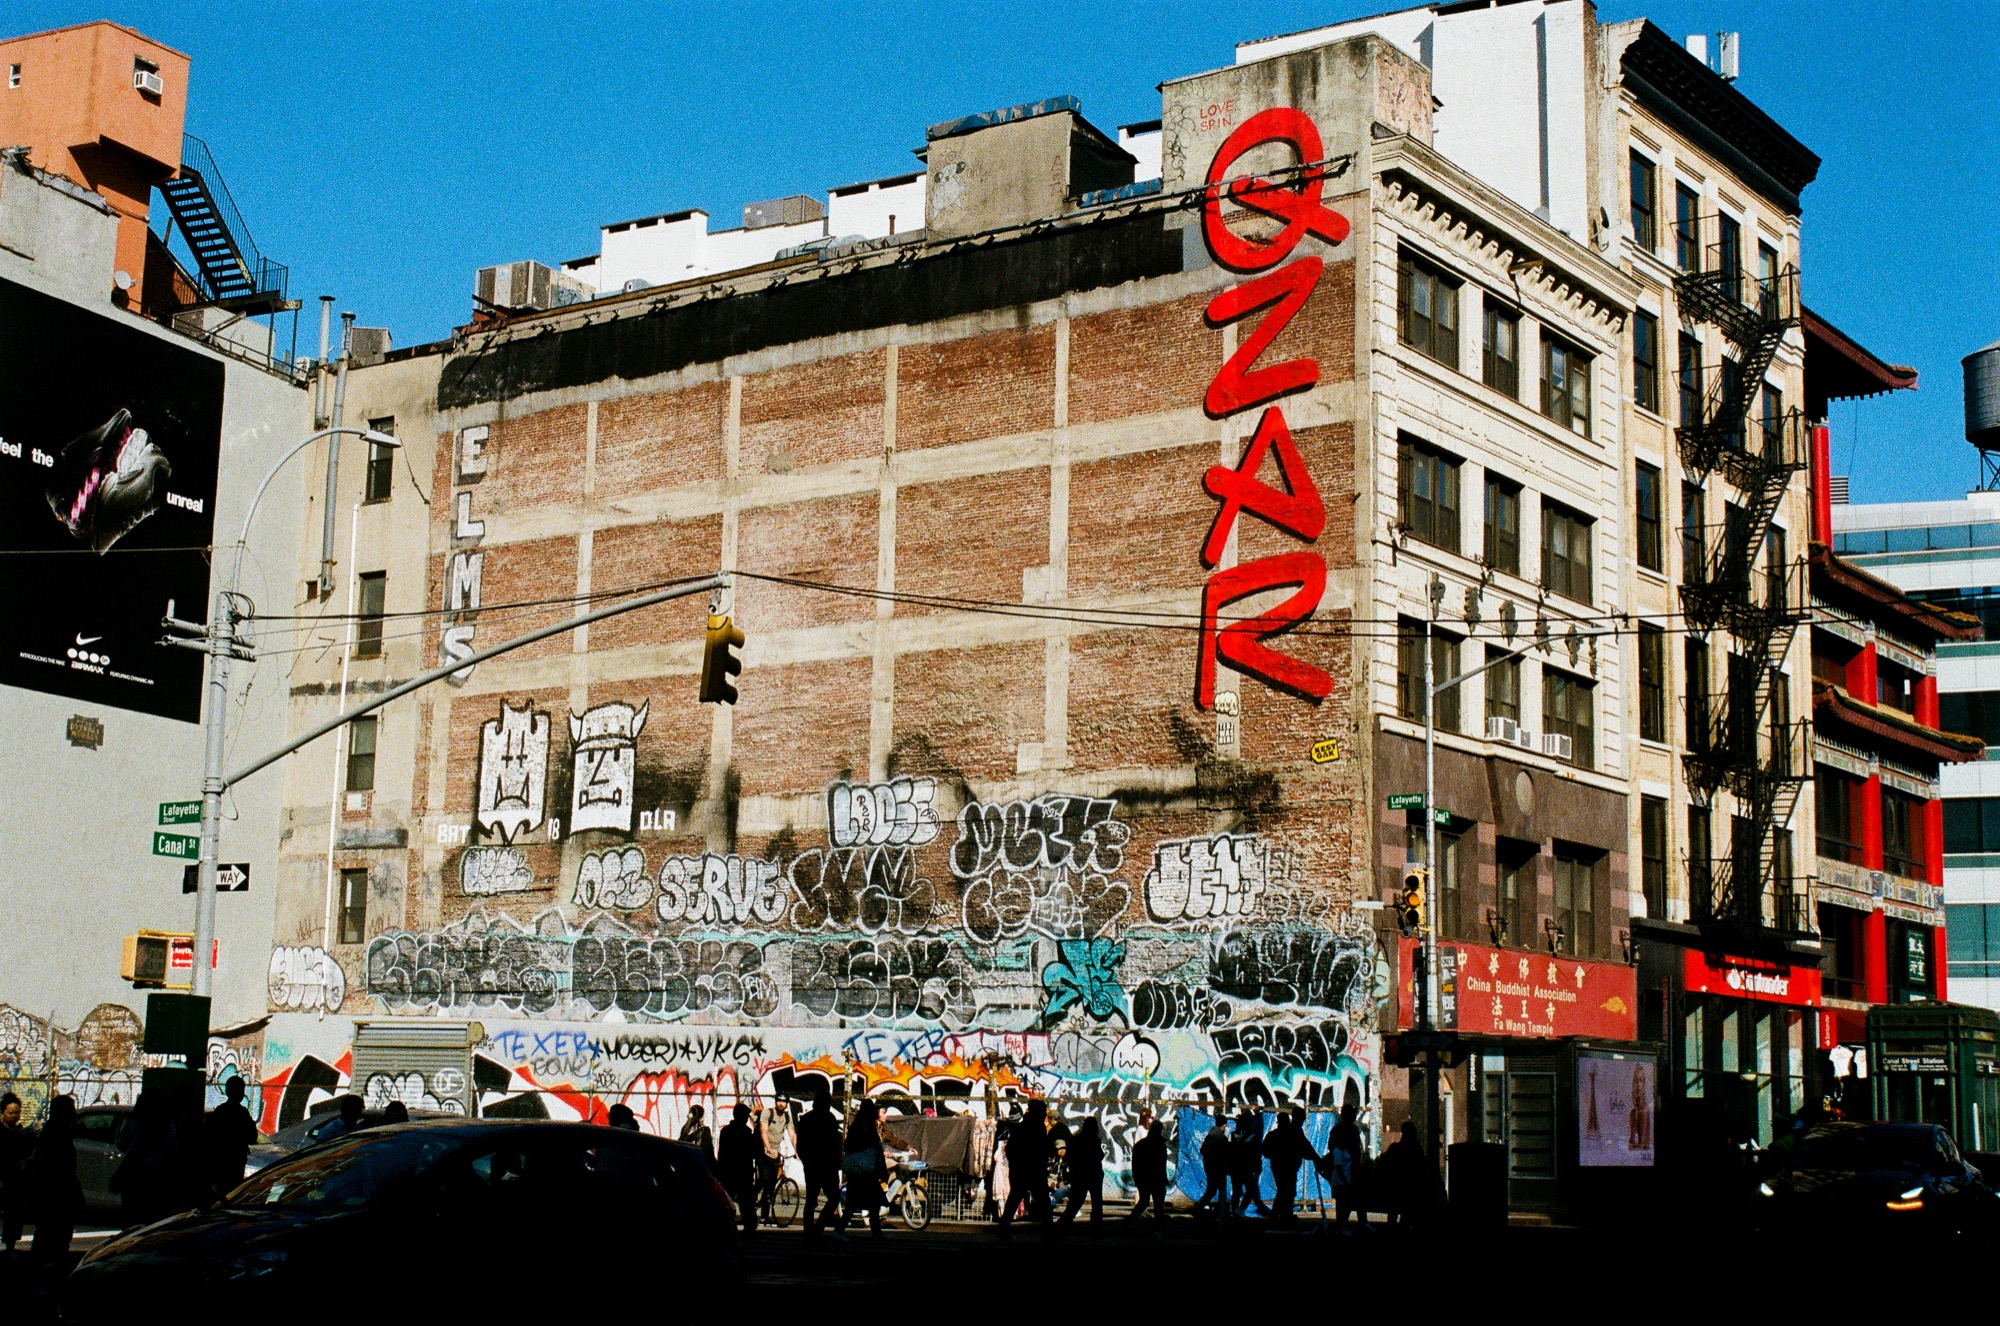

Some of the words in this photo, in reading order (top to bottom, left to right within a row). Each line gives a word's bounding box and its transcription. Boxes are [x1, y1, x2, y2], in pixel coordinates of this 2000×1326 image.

[1200, 99, 1235, 119] LOVE
[1200, 114, 1232, 132] SPIN
[31, 447, 54, 468] the
[166, 491, 204, 514] unreal
[441, 425, 489, 688] ELMS
[163, 803, 200, 818] Lafayette
[1391, 794, 1422, 806] Lafayette
[158, 835, 186, 856] Canal
[188, 838, 196, 849] St
[437, 823, 471, 844] BAT
[220, 872, 240, 883] WAY
[656, 852, 789, 924] SERVE
[1457, 948, 1586, 989] 中華佛教會
[1467, 976, 1491, 993] China
[1495, 980, 1530, 997] Buddhist
[1534, 985, 1577, 1002] Association
[1740, 969, 1789, 996] Santander
[1491, 995, 1556, 1022] 法王寺
[1493, 1017, 1504, 1030] Fa
[1505, 1019, 1526, 1035] Wang
[1527, 1021, 1554, 1036] Temple
[493, 1030, 599, 1060] TEXER
[842, 1029, 945, 1065] TEXER
